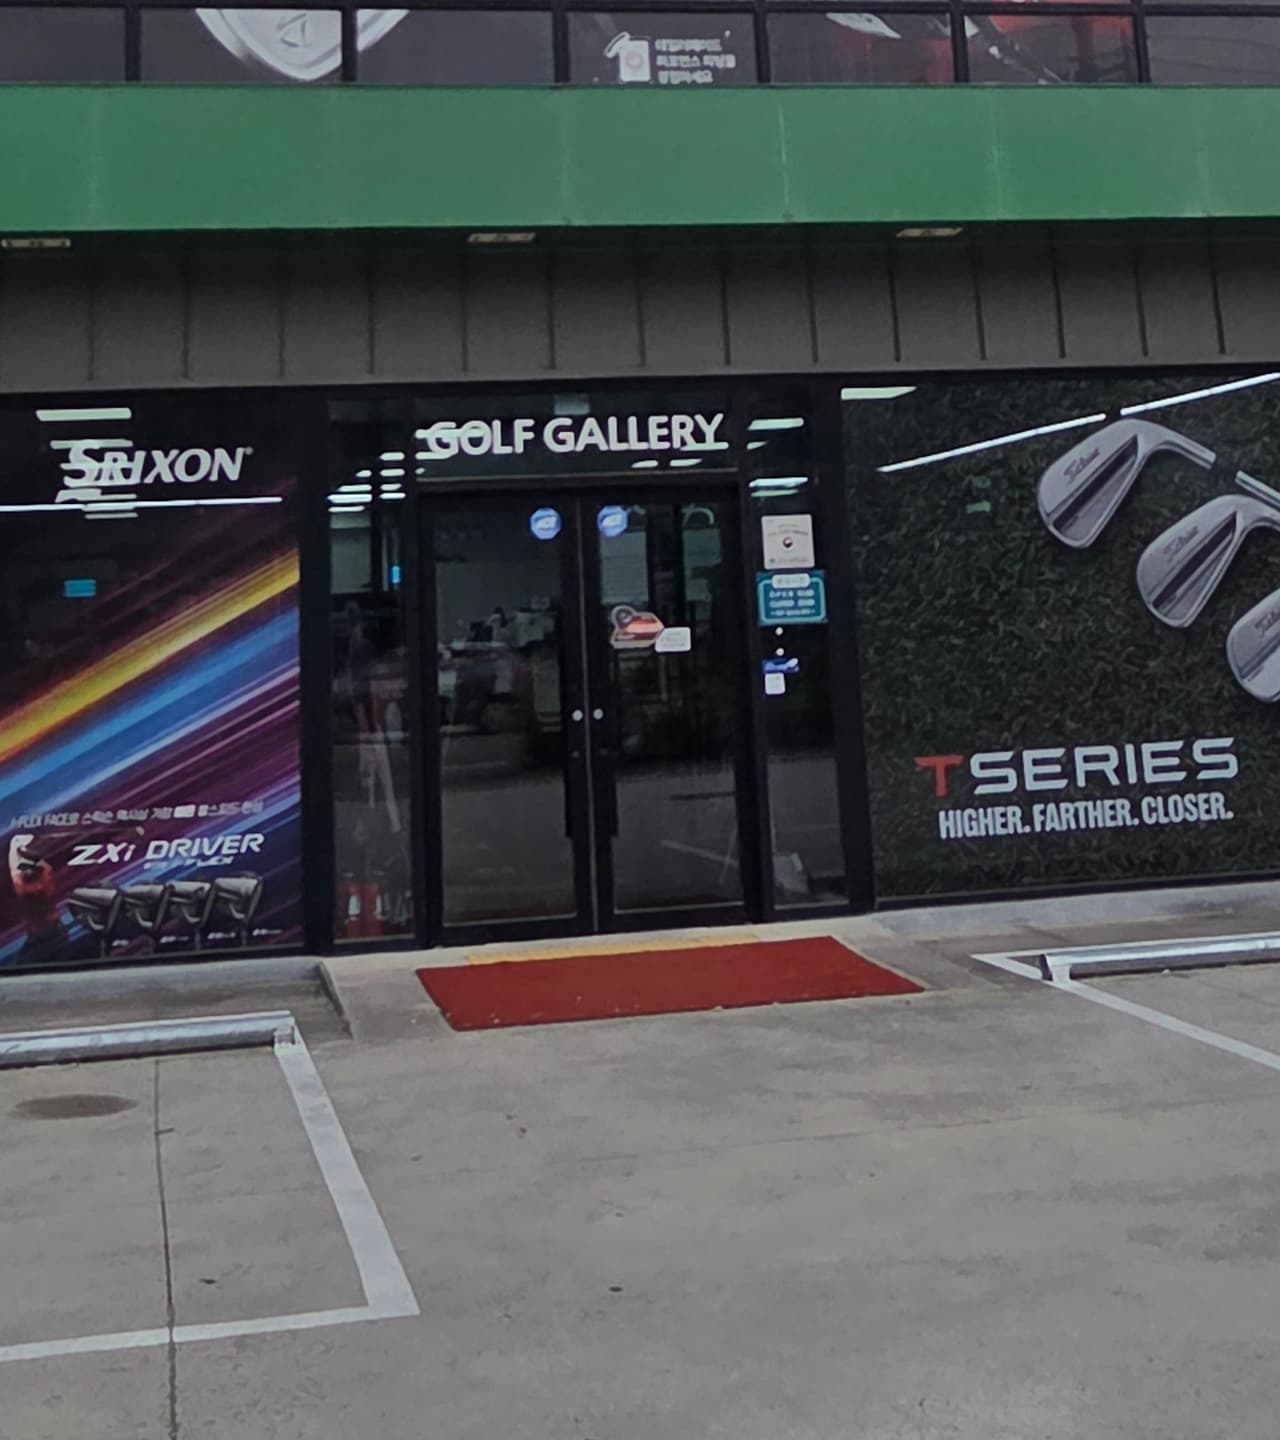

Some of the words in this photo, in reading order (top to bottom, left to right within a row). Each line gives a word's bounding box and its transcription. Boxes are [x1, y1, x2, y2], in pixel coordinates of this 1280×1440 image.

[426, 419, 536, 456] GOLF
[542, 412, 725, 453] GALLERY
[938, 805, 1032, 840] HIGHER.
[1033, 798, 1140, 833] FARTHER.
[1141, 791, 1235, 825] CLOSER.
[67, 842, 137, 867] ZXi
[144, 832, 265, 860] DRIVER
